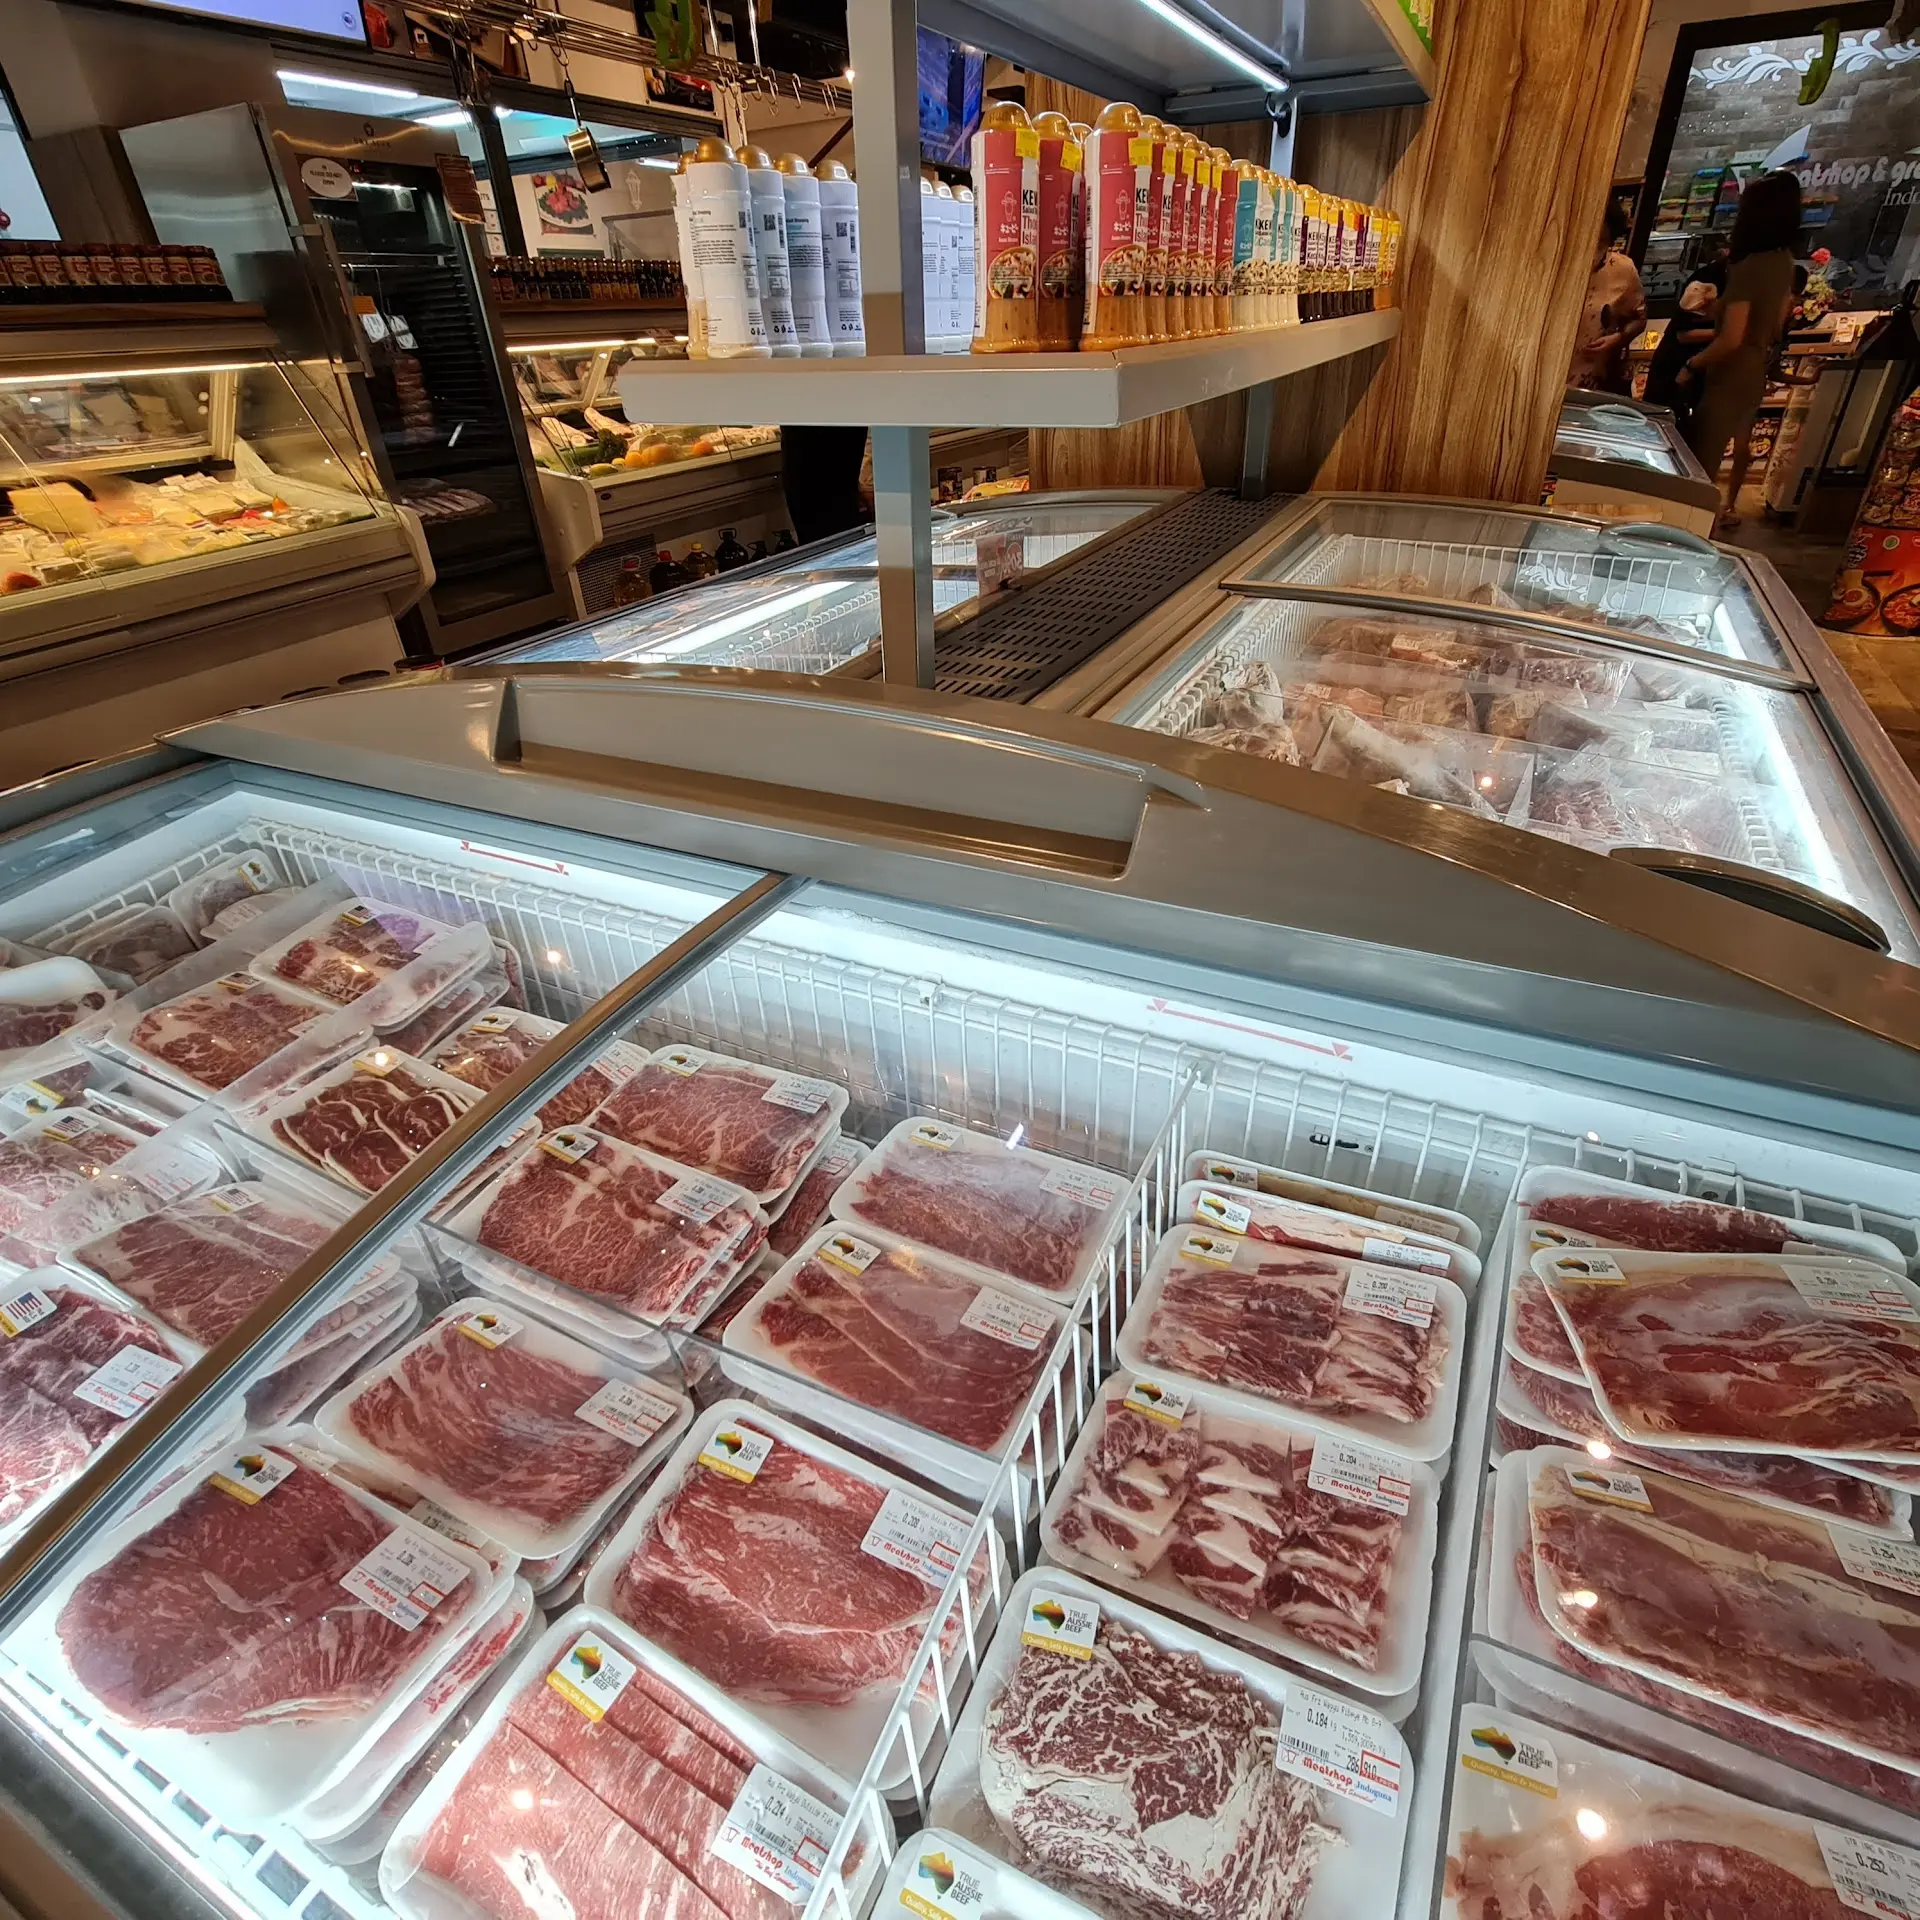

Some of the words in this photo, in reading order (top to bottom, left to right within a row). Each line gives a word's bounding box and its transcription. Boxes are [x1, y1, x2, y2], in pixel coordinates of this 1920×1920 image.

[1792, 162, 1871, 189] atshop
[1330, 1479, 1372, 1497] Meatshop
[883, 1540, 921, 1566] Meatshop
[1066, 1617, 1093, 1630] AUSSIE
[1069, 1609, 1088, 1620] TRUE
[1065, 1624, 1084, 1634] BEEF
[605, 1663, 622, 1680] TRUE
[592, 1677, 609, 1692] BEEF
[599, 1671, 621, 1691] AUSSIE
[1306, 1706, 1328, 1730] 0.184
[1519, 1741, 1544, 1755] TRUE
[1518, 1749, 1553, 1769] AUSSIE
[1518, 1757, 1541, 1770] BEEF
[1302, 1755, 1352, 1787] Meatshop
[1355, 1779, 1392, 1803] Indoguna
[763, 1794, 788, 1819] 0.214
[739, 1835, 785, 1871] Meatshop
[960, 1870, 981, 1888] TRUE
[950, 1888, 972, 1906] BEEF
[954, 1881, 984, 1903] AUSSIE
